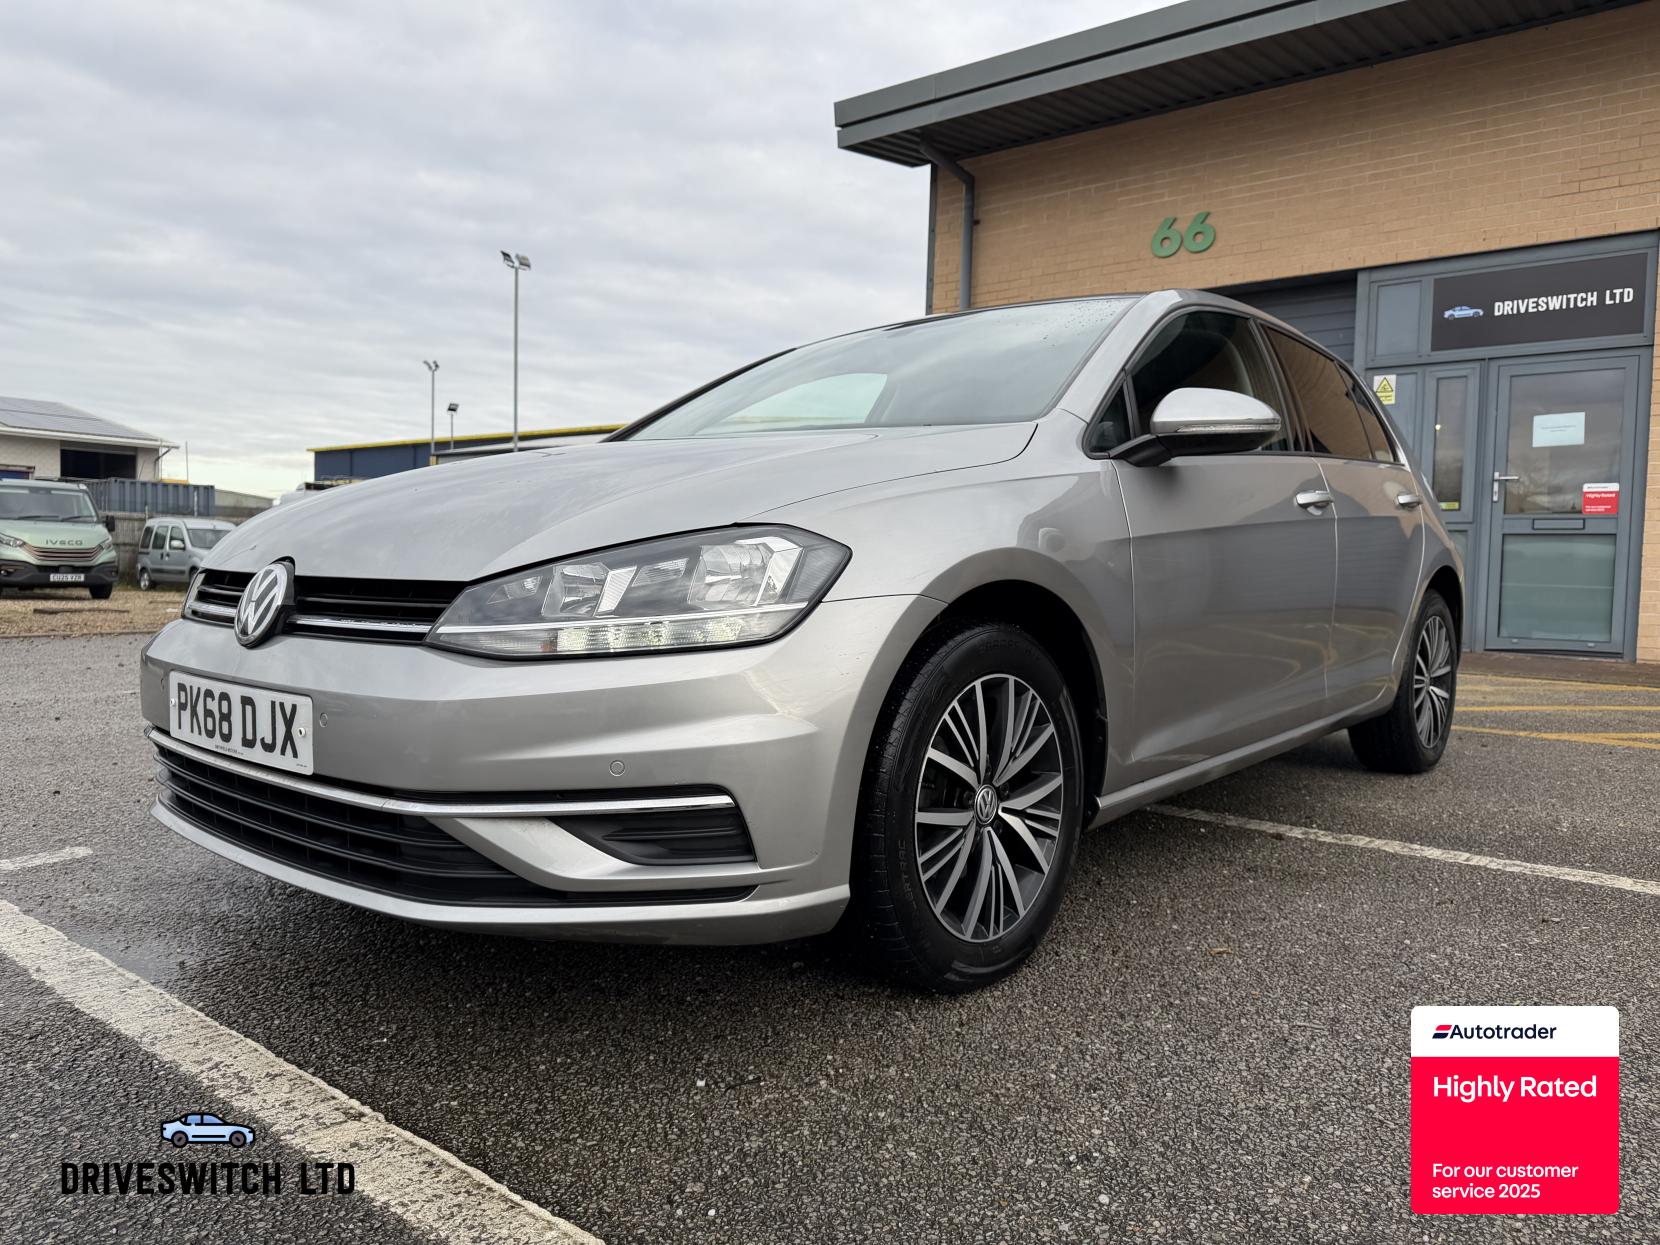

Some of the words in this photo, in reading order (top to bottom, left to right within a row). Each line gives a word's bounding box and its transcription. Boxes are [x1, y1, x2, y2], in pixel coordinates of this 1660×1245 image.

[1151, 211, 1216, 258] 66
[1494, 291, 1598, 316] DRIVESWITCH
[1605, 287, 1634, 305] LTD
[177, 682, 232, 743] PK68
[240, 695, 298, 759] DJX
